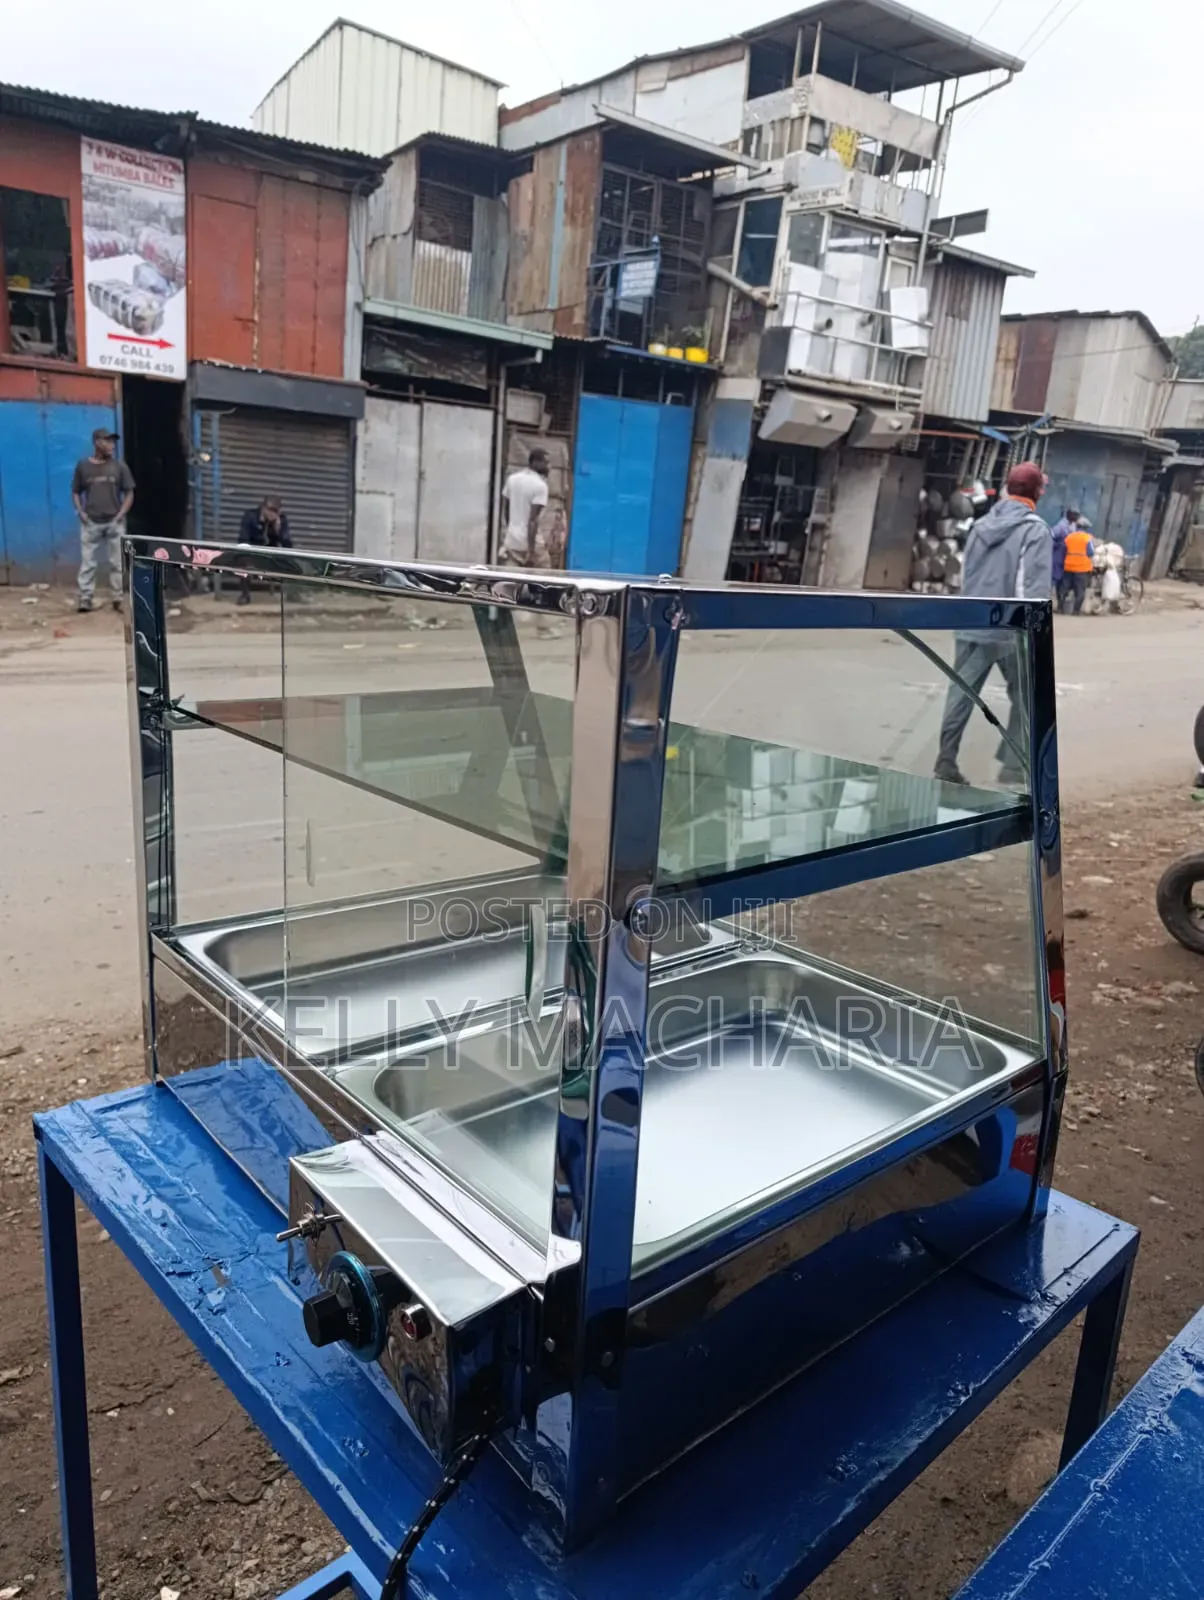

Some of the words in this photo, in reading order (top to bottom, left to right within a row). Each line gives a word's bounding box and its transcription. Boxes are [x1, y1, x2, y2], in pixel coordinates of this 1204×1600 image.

[93, 161, 141, 181] MITUMBA
[120, 344, 153, 358] CALL
[99, 355, 127, 368] 0746
